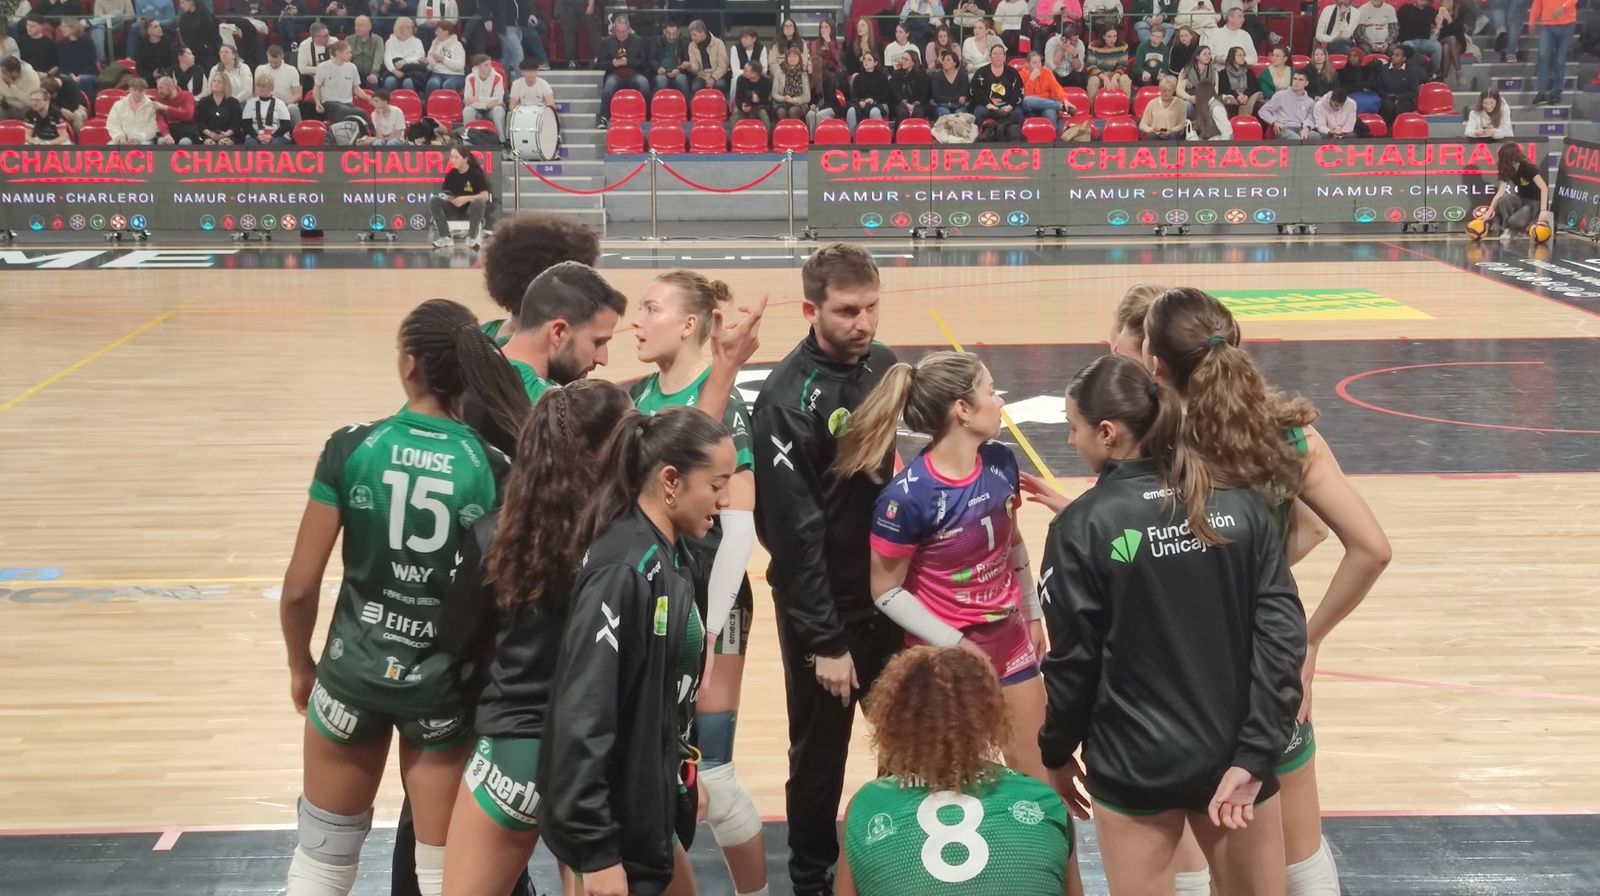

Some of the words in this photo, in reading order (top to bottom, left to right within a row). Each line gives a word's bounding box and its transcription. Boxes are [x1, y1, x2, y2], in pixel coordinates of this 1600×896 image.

[0, 150, 153, 174] CHAURACI
[170, 150, 325, 174] CHAURACI
[341, 150, 493, 174] CHAURI
[820, 148, 1041, 173] CHAURACI
[1067, 146, 1289, 171] CHAURACI
[1314, 142, 1537, 168] CHAURAI
[2, 193, 56, 203] NAMUR
[66, 193, 154, 203] CHARLEROI
[173, 193, 227, 203] NAMUR
[237, 193, 324, 203] CHARLEROI
[343, 193, 397, 203] NAMUR
[823, 190, 899, 202] NAMUR
[915, 189, 1041, 201] CHARLEROI
[1070, 188, 1146, 200] NAMUR
[1162, 187, 1288, 198] CHARLEROI
[1317, 185, 1393, 197] NAMUR
[1558, 185, 1588, 201] NAMUR
[391, 445, 455, 474] LOUISE
[382, 469, 454, 553] 15
[980, 516, 995, 552] 1
[1147, 511, 1236, 542] Fundión
[1150, 538, 1214, 558] Unicaj
[391, 561, 434, 583] WAY
[385, 611, 438, 638] EIFFA
[916, 790, 990, 883] 8
